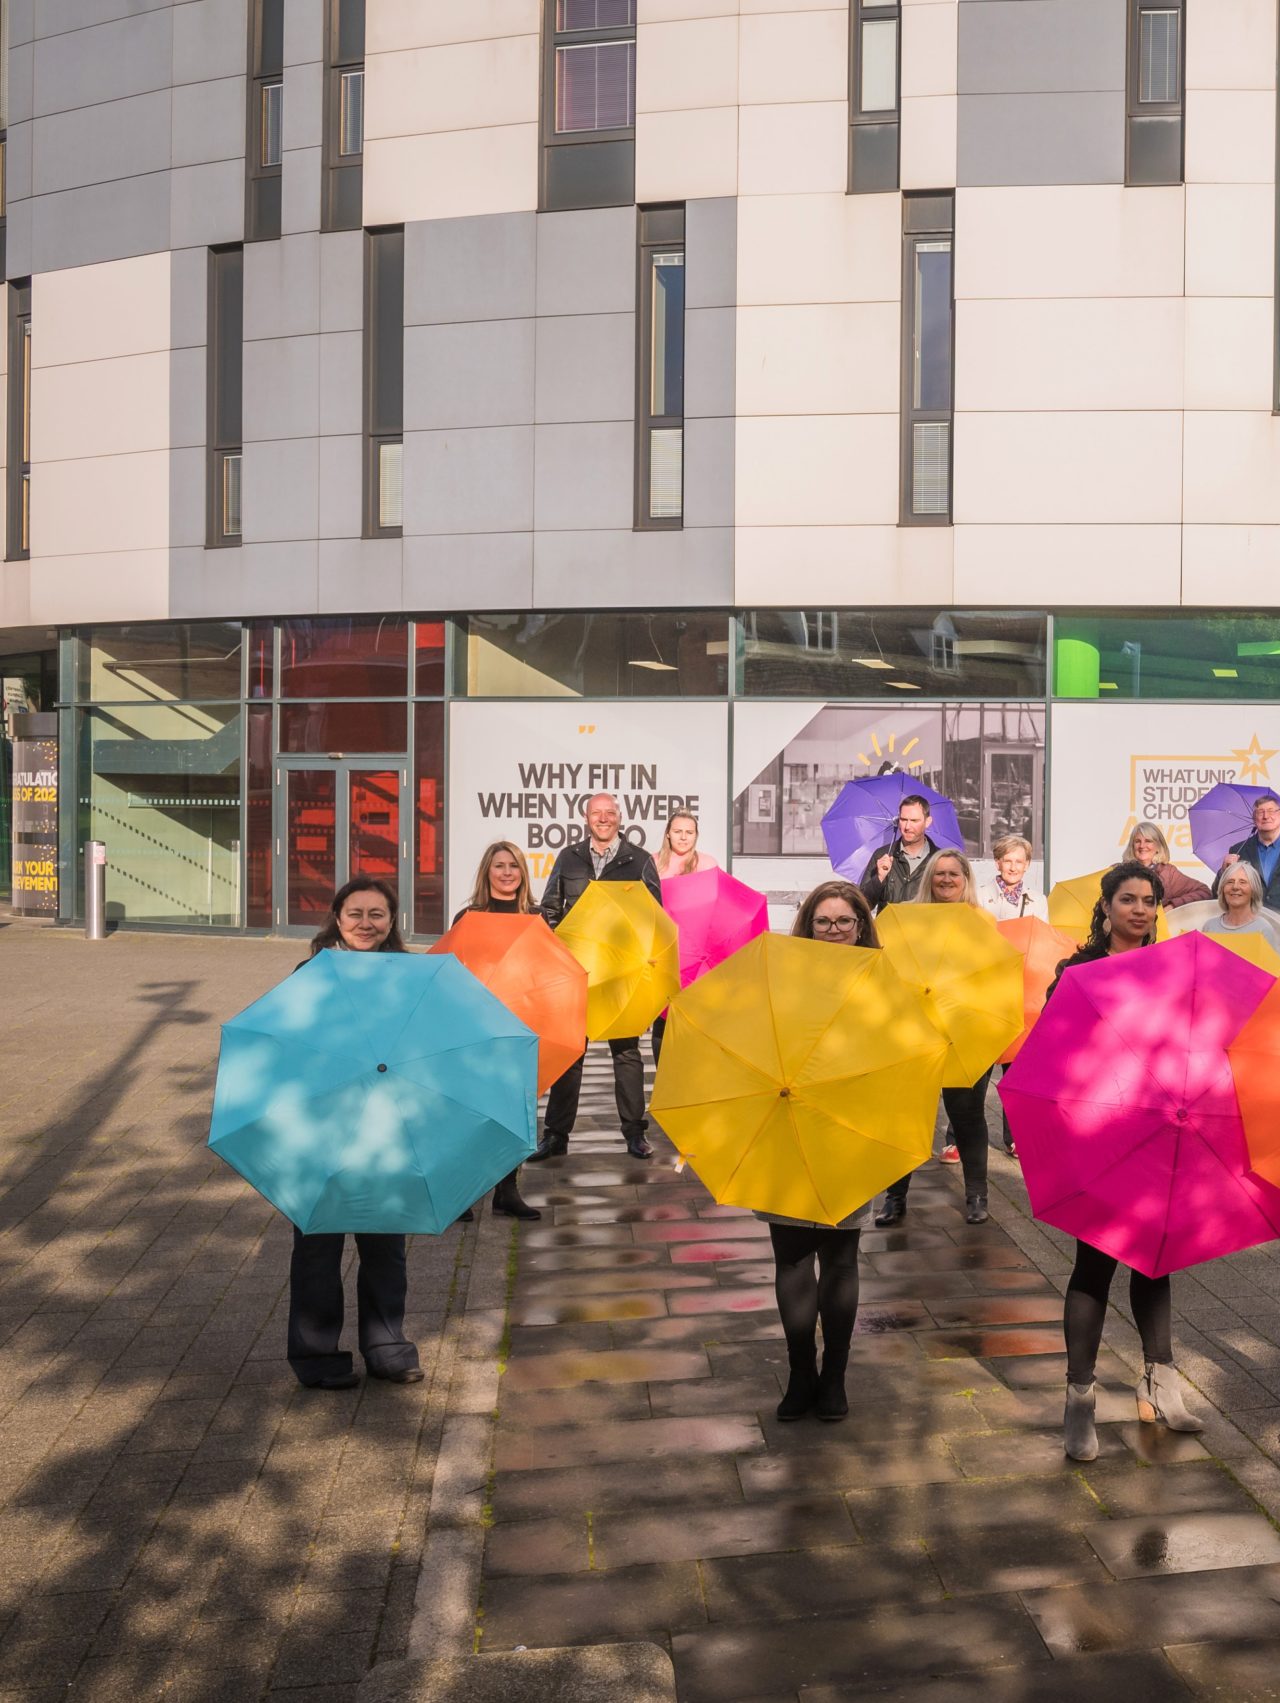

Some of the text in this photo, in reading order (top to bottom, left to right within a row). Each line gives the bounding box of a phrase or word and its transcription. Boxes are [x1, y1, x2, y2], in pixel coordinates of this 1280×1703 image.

[518, 763, 657, 790] WHY FIT IN
[21, 787, 33, 802] OF
[34, 787, 57, 802] 202
[477, 792, 556, 819] WHEN
[623, 794, 699, 821] WERE
[25, 860, 54, 876] YOUR
